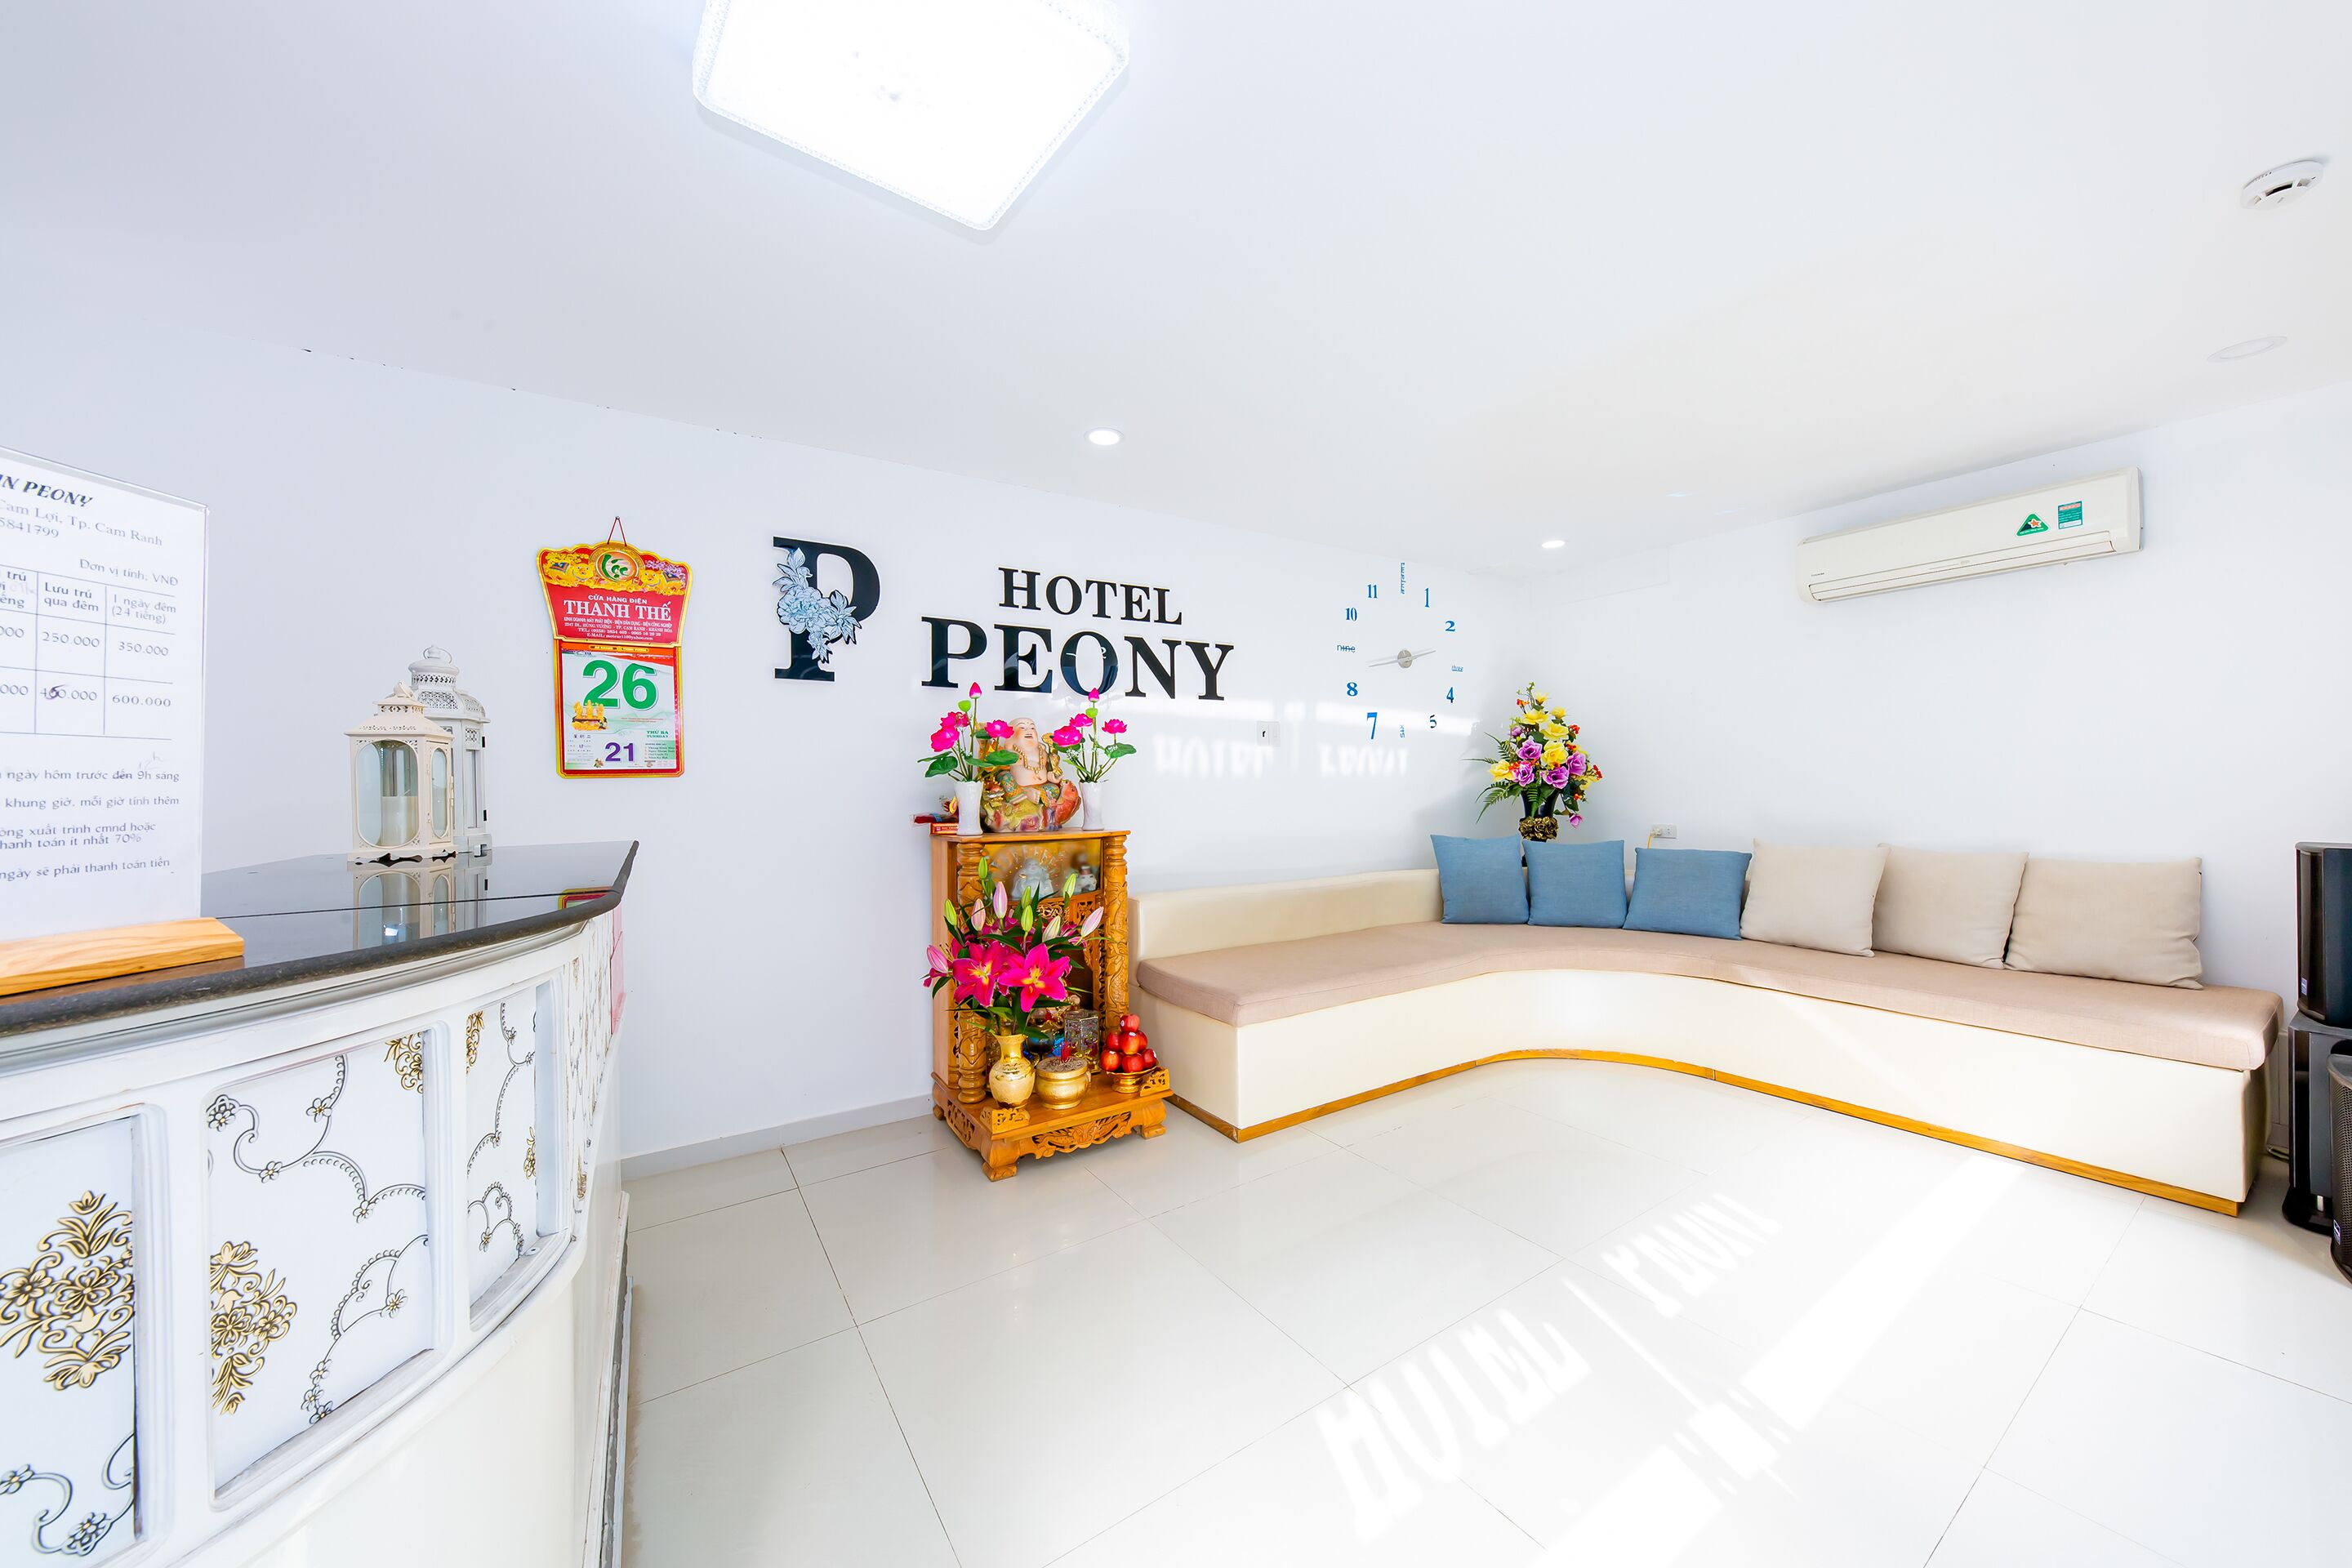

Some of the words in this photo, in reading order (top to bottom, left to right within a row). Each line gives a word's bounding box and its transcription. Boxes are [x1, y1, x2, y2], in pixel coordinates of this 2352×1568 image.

[23, 480, 93, 507] PEONY
[96, 522, 126, 538] Cam
[131, 530, 163, 546] Ranh
[45, 581, 69, 595] Lưu
[74, 587, 92, 599] trú
[999, 567, 1183, 625] HOTEL
[1367, 584, 1378, 599] 11
[1424, 588, 1430, 608] 1
[44, 596, 67, 608] qua
[73, 599, 99, 612] đêm
[123, 596, 150, 609] ngày
[154, 602, 176, 613] đêm
[564, 599, 630, 618] THANH
[635, 601, 671, 621] THẾ
[1345, 608, 1357, 621] 10
[1445, 621, 1456, 632] 2
[42, 631, 100, 648] 250.000
[118, 641, 168, 657] 350.000
[921, 615, 1234, 701] PEONY
[582, 660, 657, 710] 26
[1347, 682, 1358, 697] 8
[112, 694, 172, 707] 600.000
[1446, 687, 1454, 702] 4
[1367, 712, 1378, 739] 7
[1429, 715, 1437, 728] 5
[605, 742, 634, 762] 21
[7, 769, 40, 782] ngày
[44, 769, 71, 780] hôm
[155, 770, 180, 782] sáng
[5, 798, 47, 810] khung
[106, 797, 124, 808] giờ
[128, 796, 149, 806] tính
[154, 795, 180, 805] thêm
[29, 823, 56, 836] xuất
[95, 823, 127, 834] cmnd
[130, 822, 157, 834] hoặc
[38, 837, 65, 848] toán
[82, 833, 109, 845] nhất
[114, 833, 142, 844] 70%
[53, 864, 80, 878] phải
[85, 862, 118, 873] thanh
[122, 859, 146, 871] toán
